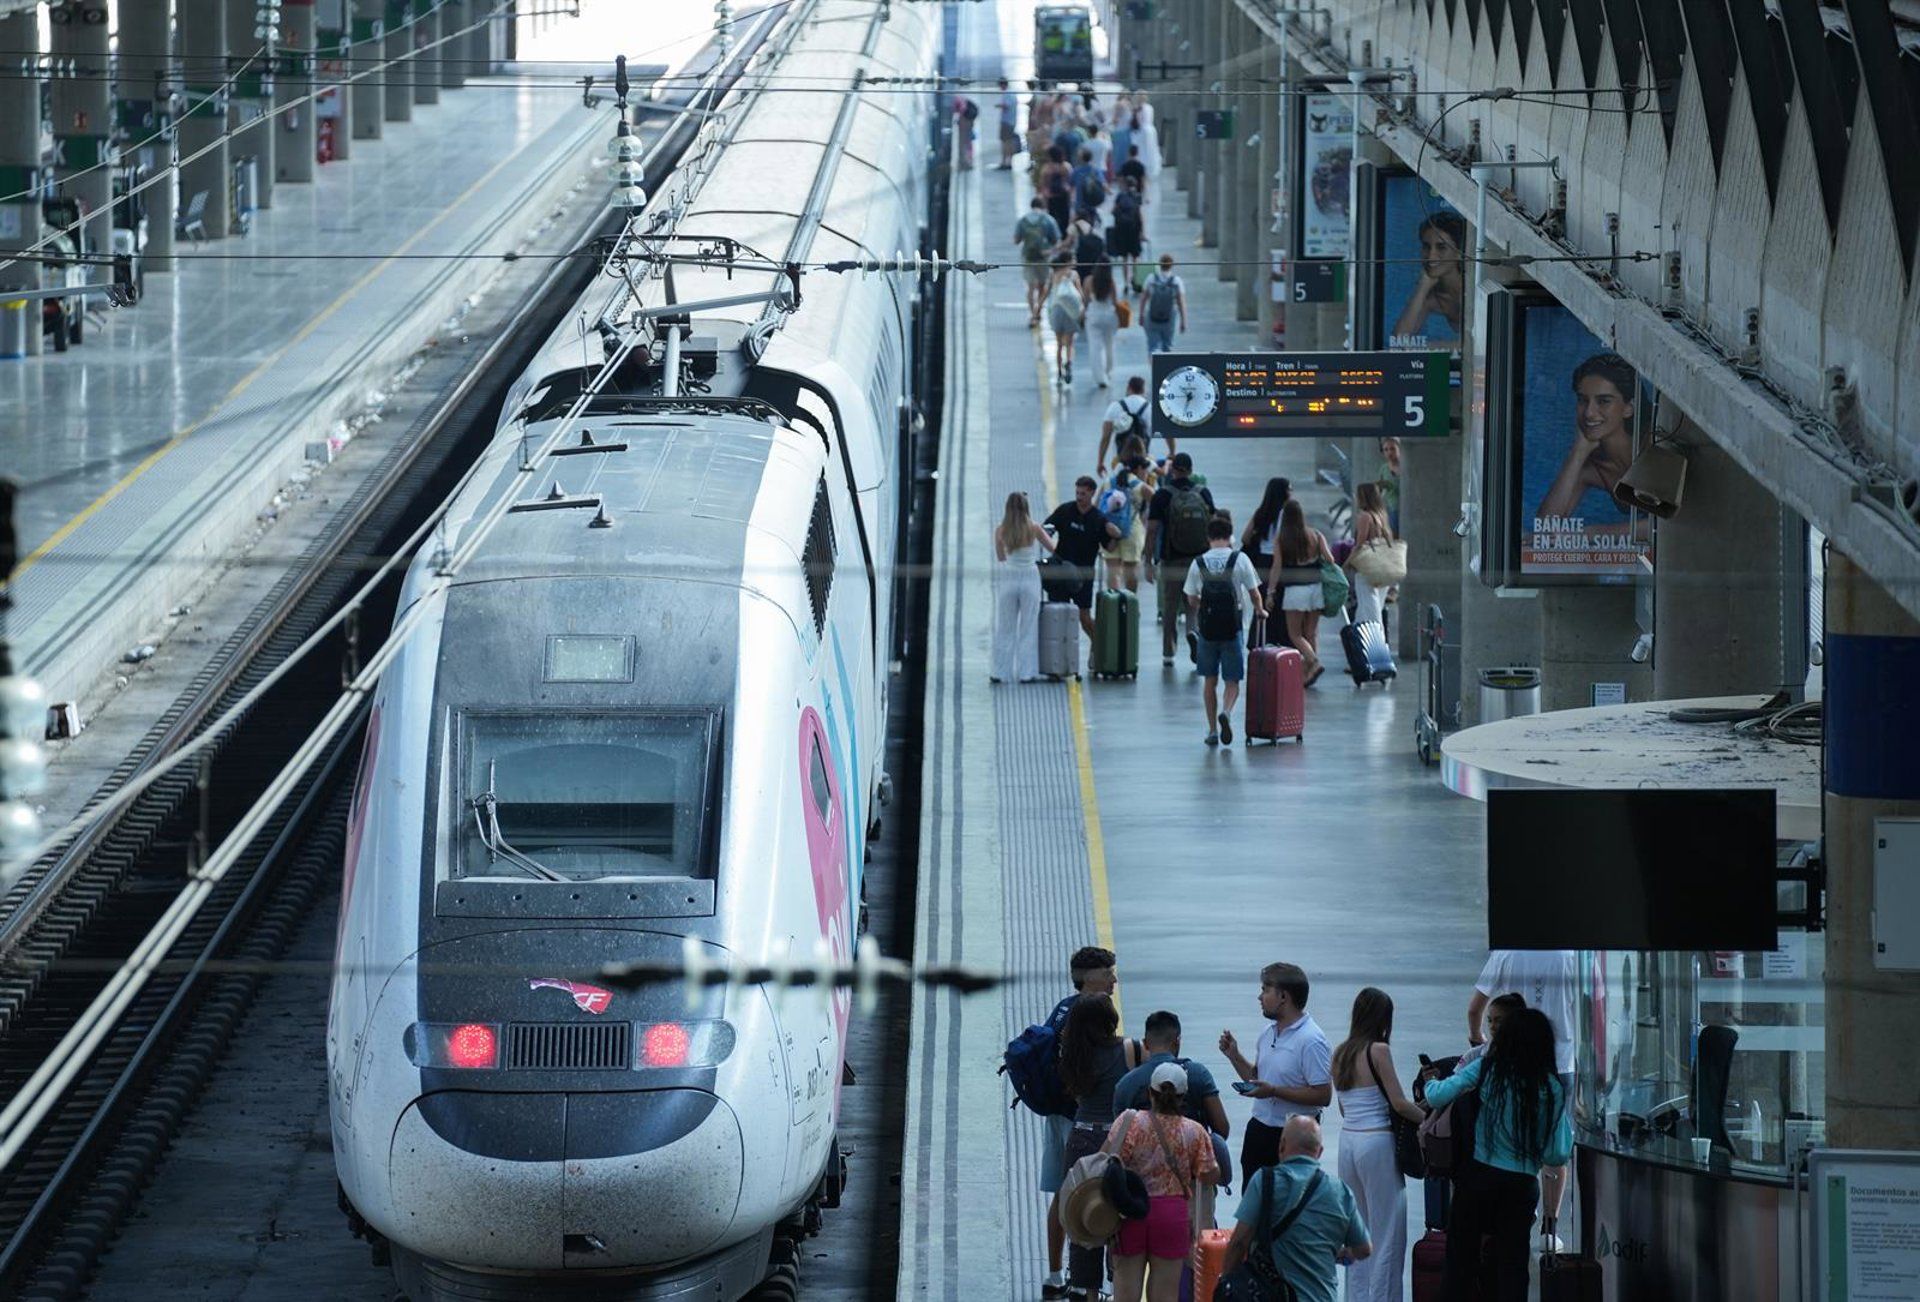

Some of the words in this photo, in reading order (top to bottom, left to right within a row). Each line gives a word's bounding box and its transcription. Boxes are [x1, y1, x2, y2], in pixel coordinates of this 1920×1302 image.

[1295, 282, 1306, 302] 5
[1226, 362, 1245, 370] Hora
[1276, 361, 1294, 370] Tren
[1410, 360, 1424, 369] Vía
[1226, 388, 1257, 396] Destino
[1405, 395, 1424, 427] 5
[1534, 515, 1584, 533] BÁÑATE
[1533, 534, 1550, 550] EN
[1554, 534, 1590, 550] AGUA
[1851, 1186, 1906, 1197] Documentos
